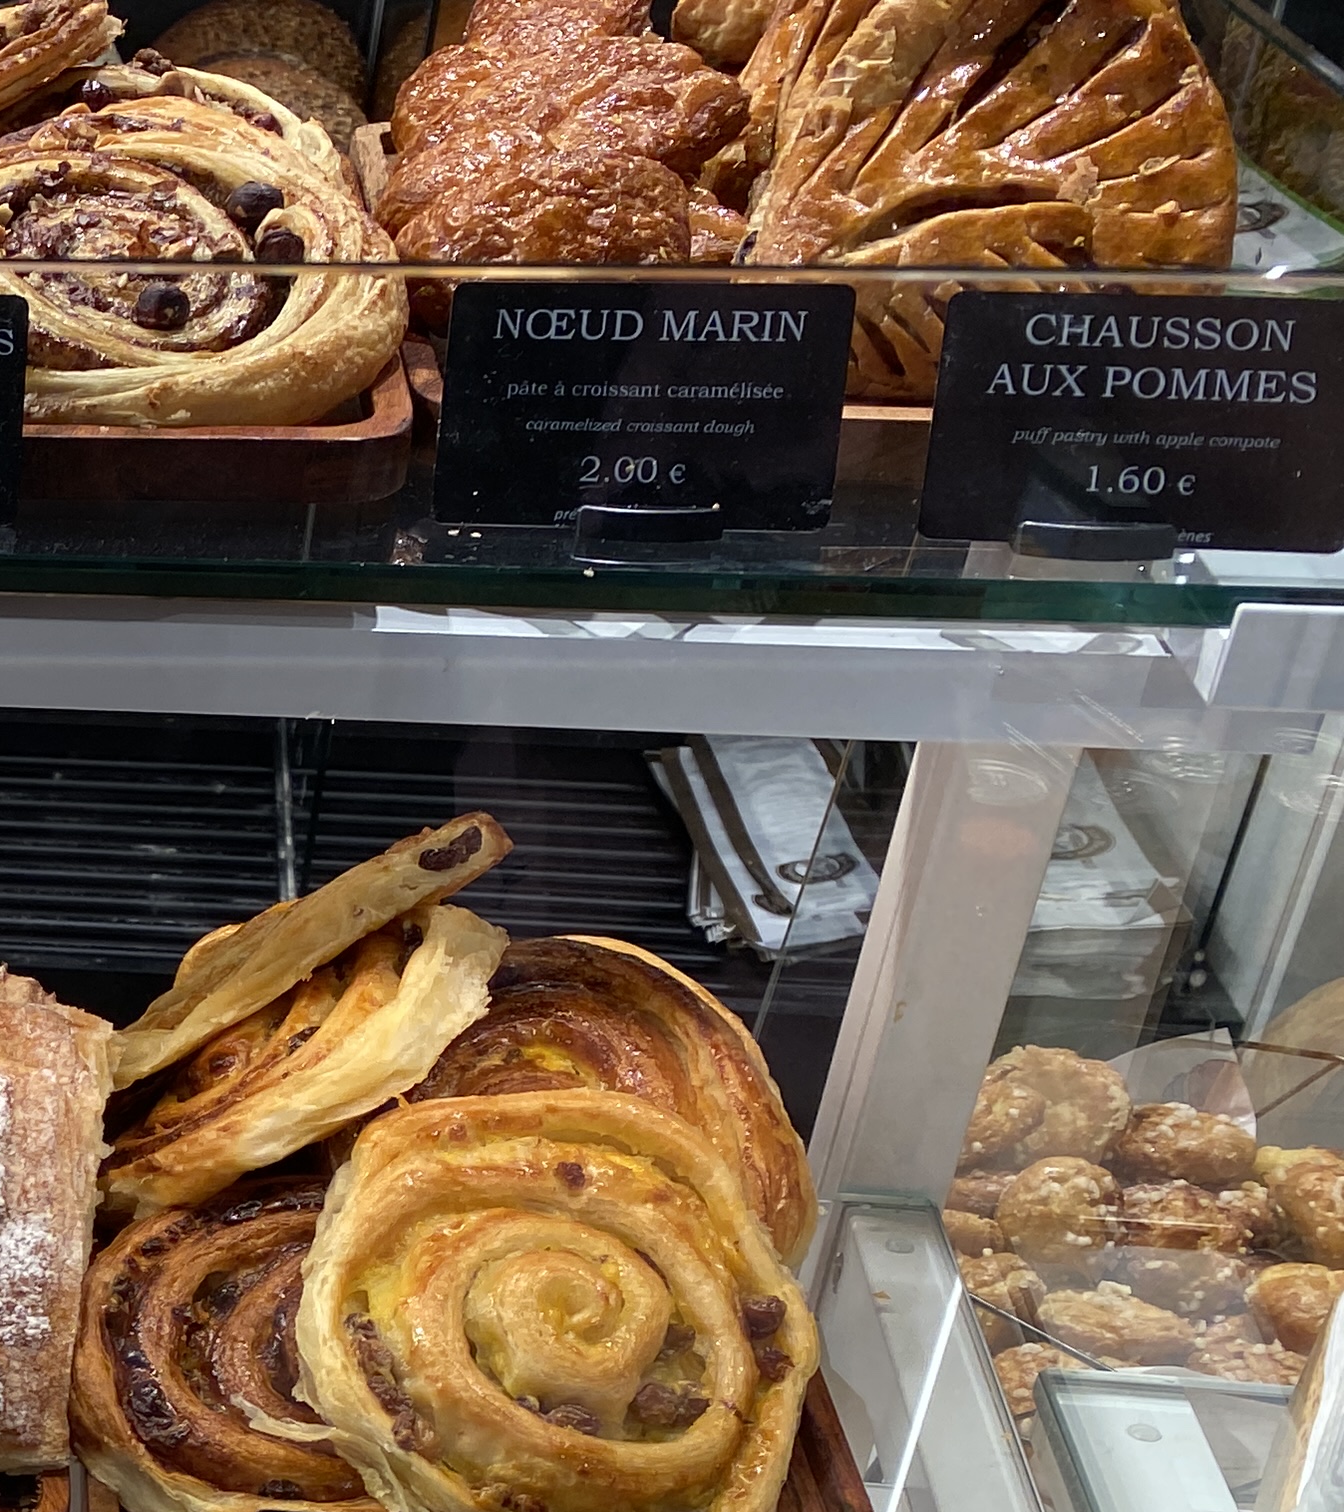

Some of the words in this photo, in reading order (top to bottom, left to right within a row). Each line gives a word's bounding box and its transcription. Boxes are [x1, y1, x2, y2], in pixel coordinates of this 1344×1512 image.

[493, 309, 644, 340] NŒUD
[659, 310, 809, 342] MARIN
[1025, 313, 1296, 353] CHAUSSON
[506, 381, 547, 400] pâte
[554, 381, 565, 397] à
[572, 383, 660, 398] croissant
[667, 382, 784, 400] caramélisée
[986, 363, 1087, 398] AUX
[1101, 366, 1317, 404] POMMES
[526, 419, 621, 432] caramelized
[627, 420, 699, 433] croissant
[704, 420, 755, 435] dough
[1012, 426, 1051, 444] puff
[1051, 429, 1108, 447] pastry
[1113, 431, 1149, 445] with
[1156, 432, 1204, 449] apple
[1210, 435, 1281, 449] compote
[579, 456, 657, 484] 2.00
[670, 464, 686, 484] €
[1085, 465, 1165, 495] 1.60
[1178, 475, 1196, 495] €
